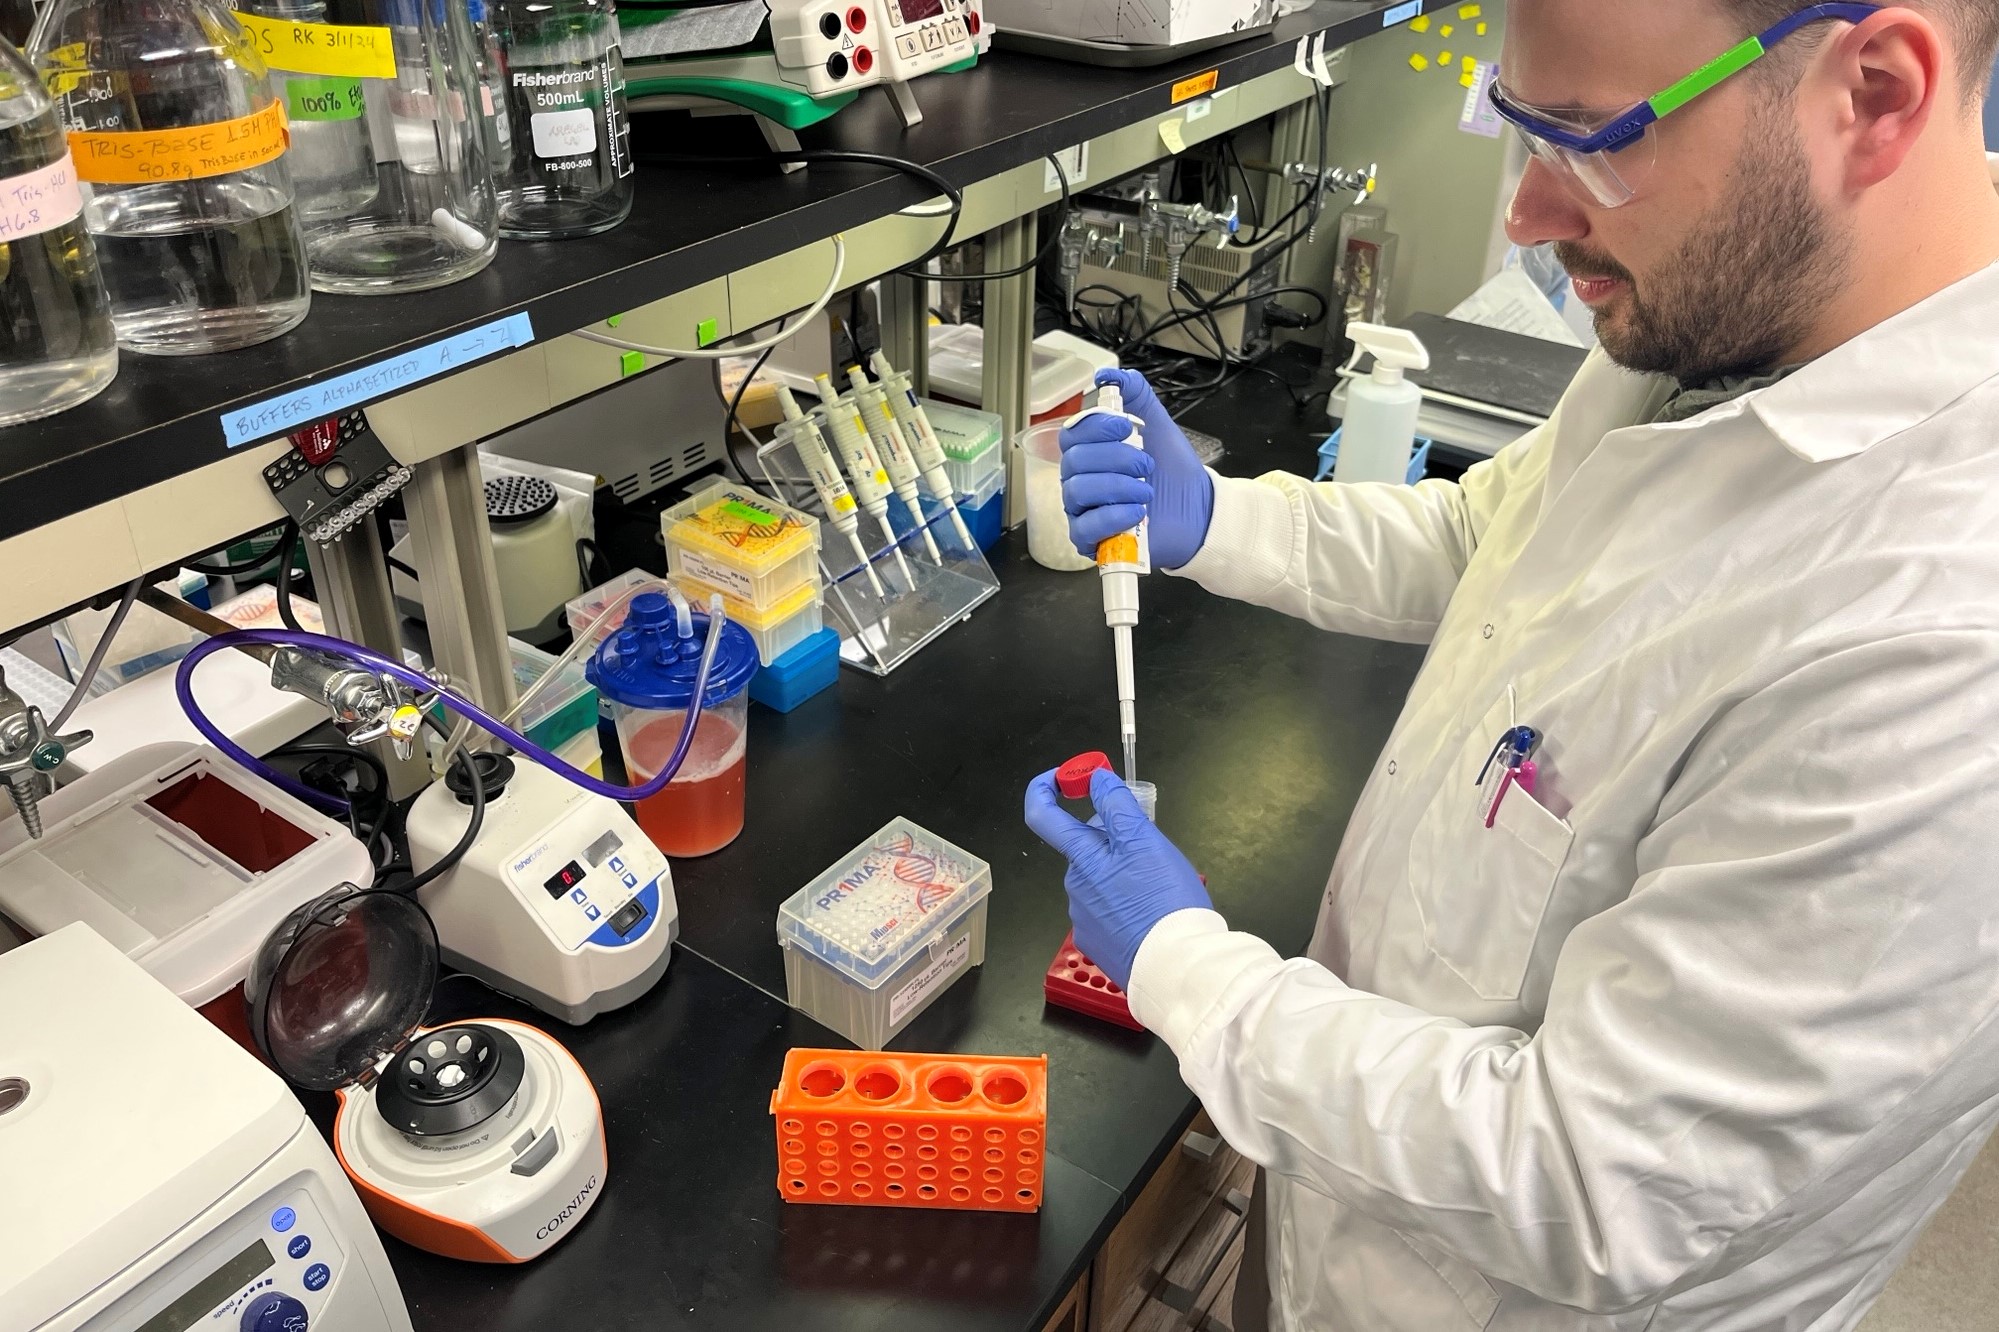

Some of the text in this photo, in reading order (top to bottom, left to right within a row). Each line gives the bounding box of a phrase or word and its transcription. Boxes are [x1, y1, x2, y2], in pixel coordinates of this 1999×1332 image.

[294, 27, 315, 46] RK
[326, 32, 375, 49] 3/1/24
[301, 92, 342, 113] 100%
[537, 91, 585, 107] 500mL
[600, 62, 617, 168] APPROXIMATE VOLUMES
[1605, 118, 1641, 142] uvex
[545, 158, 593, 172] FB-800-500
[236, 327, 510, 436] BUFFERS ALPHABETIZED A Z
[514, 843, 548, 873] fisherbrand
[816, 865, 881, 911] PR1MA
[536, 1175, 597, 1240] CORNING
[275, 1212, 292, 1228] open
[291, 1239, 309, 1255] short
[307, 1267, 324, 1282] start
[311, 1273, 327, 1287] stop
[213, 1300, 235, 1319] speed
